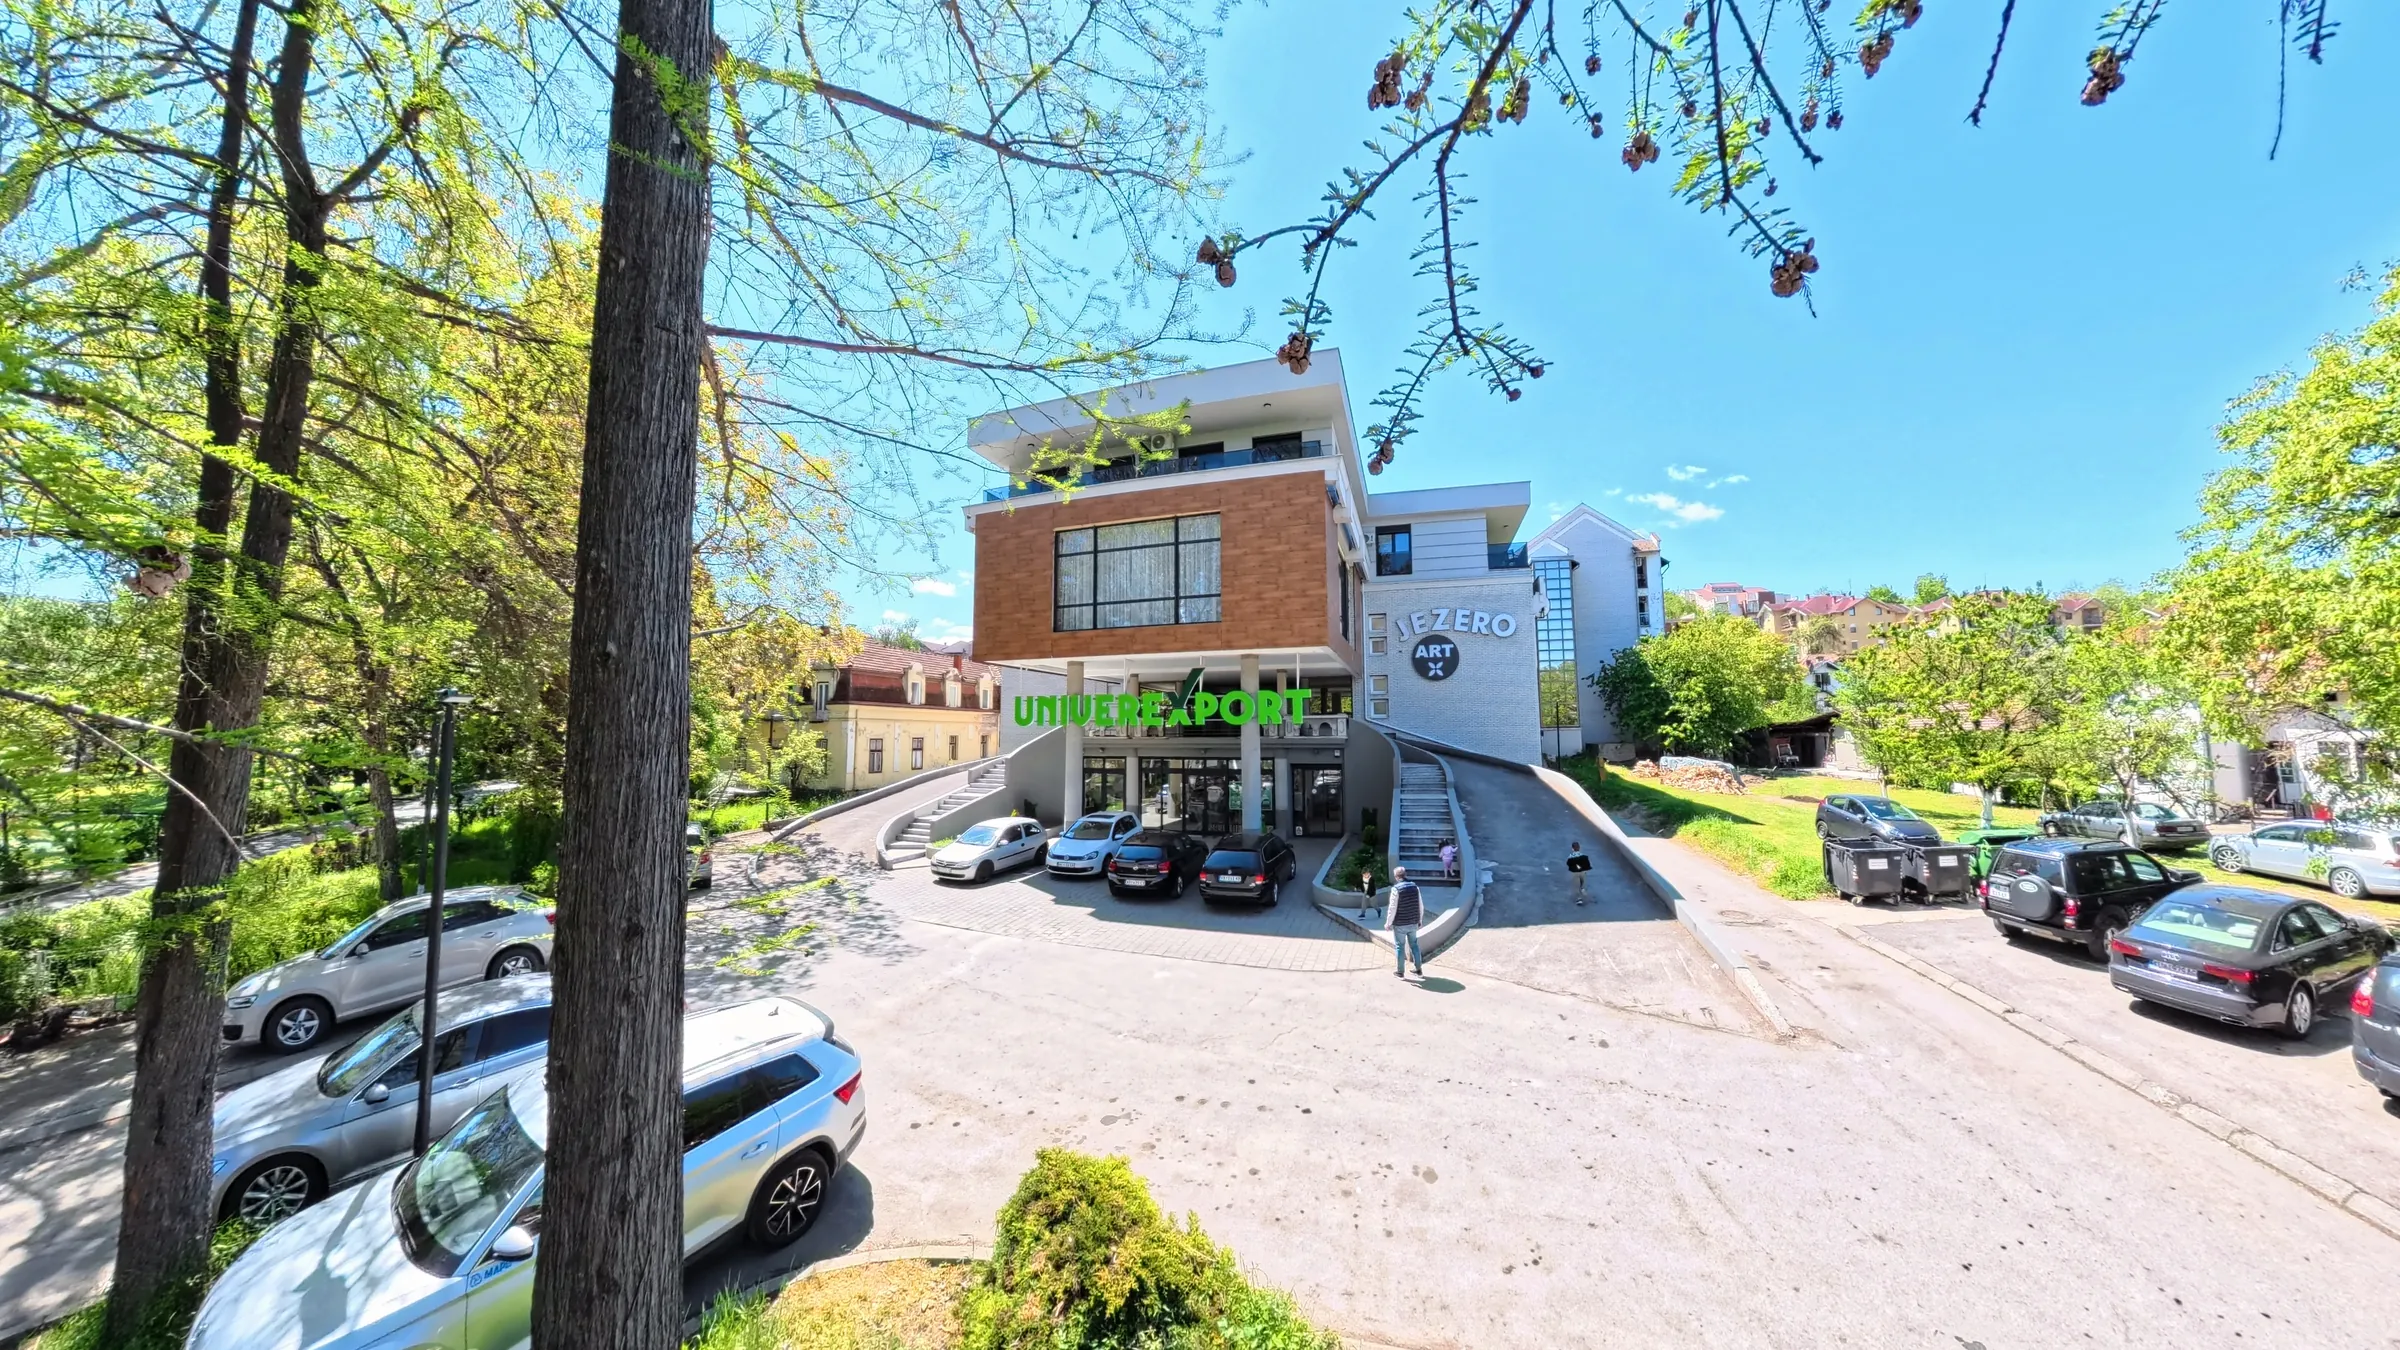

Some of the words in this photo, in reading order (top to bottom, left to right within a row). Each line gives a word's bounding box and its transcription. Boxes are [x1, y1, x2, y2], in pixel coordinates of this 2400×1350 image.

[1396, 608, 1517, 642] JEZERO
[1415, 643, 1454, 658] ART
[1014, 667, 1312, 727] UNIVEREXPORT
